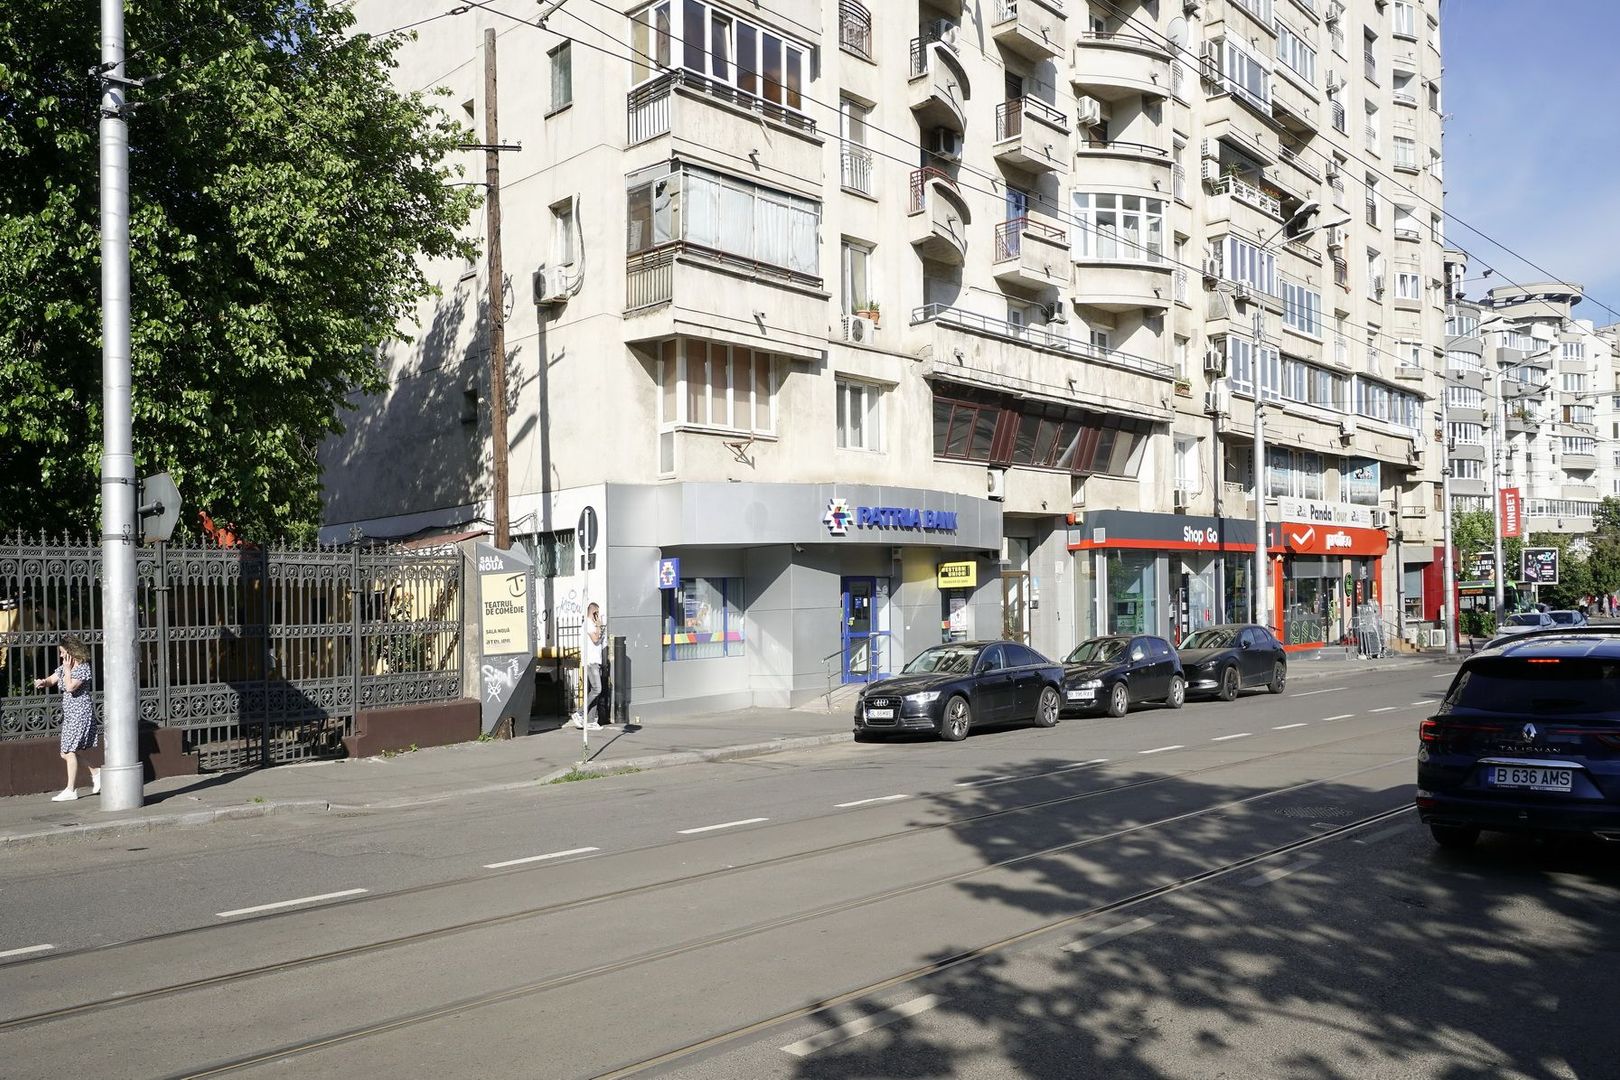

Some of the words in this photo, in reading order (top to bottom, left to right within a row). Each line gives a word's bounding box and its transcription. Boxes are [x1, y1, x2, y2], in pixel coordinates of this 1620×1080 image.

[857, 507, 922, 528] PATRIA
[922, 510, 958, 530] BANK
[1310, 504, 1332, 521] Panda
[1333, 507, 1347, 522] Tour
[1506, 493, 1516, 532] WINBET
[1183, 525, 1204, 546] Shop
[1206, 527, 1218, 543] Go
[480, 555, 500, 564] SALA
[484, 600, 513, 609] TEATRUL
[485, 608, 494, 616] DE
[495, 606, 524, 615] COMEDIE
[1500, 745, 1561, 754] TALISMAN
[1497, 769, 1508, 783] B
[1512, 769, 1538, 784] 636
[1541, 770, 1571, 786] AMS
